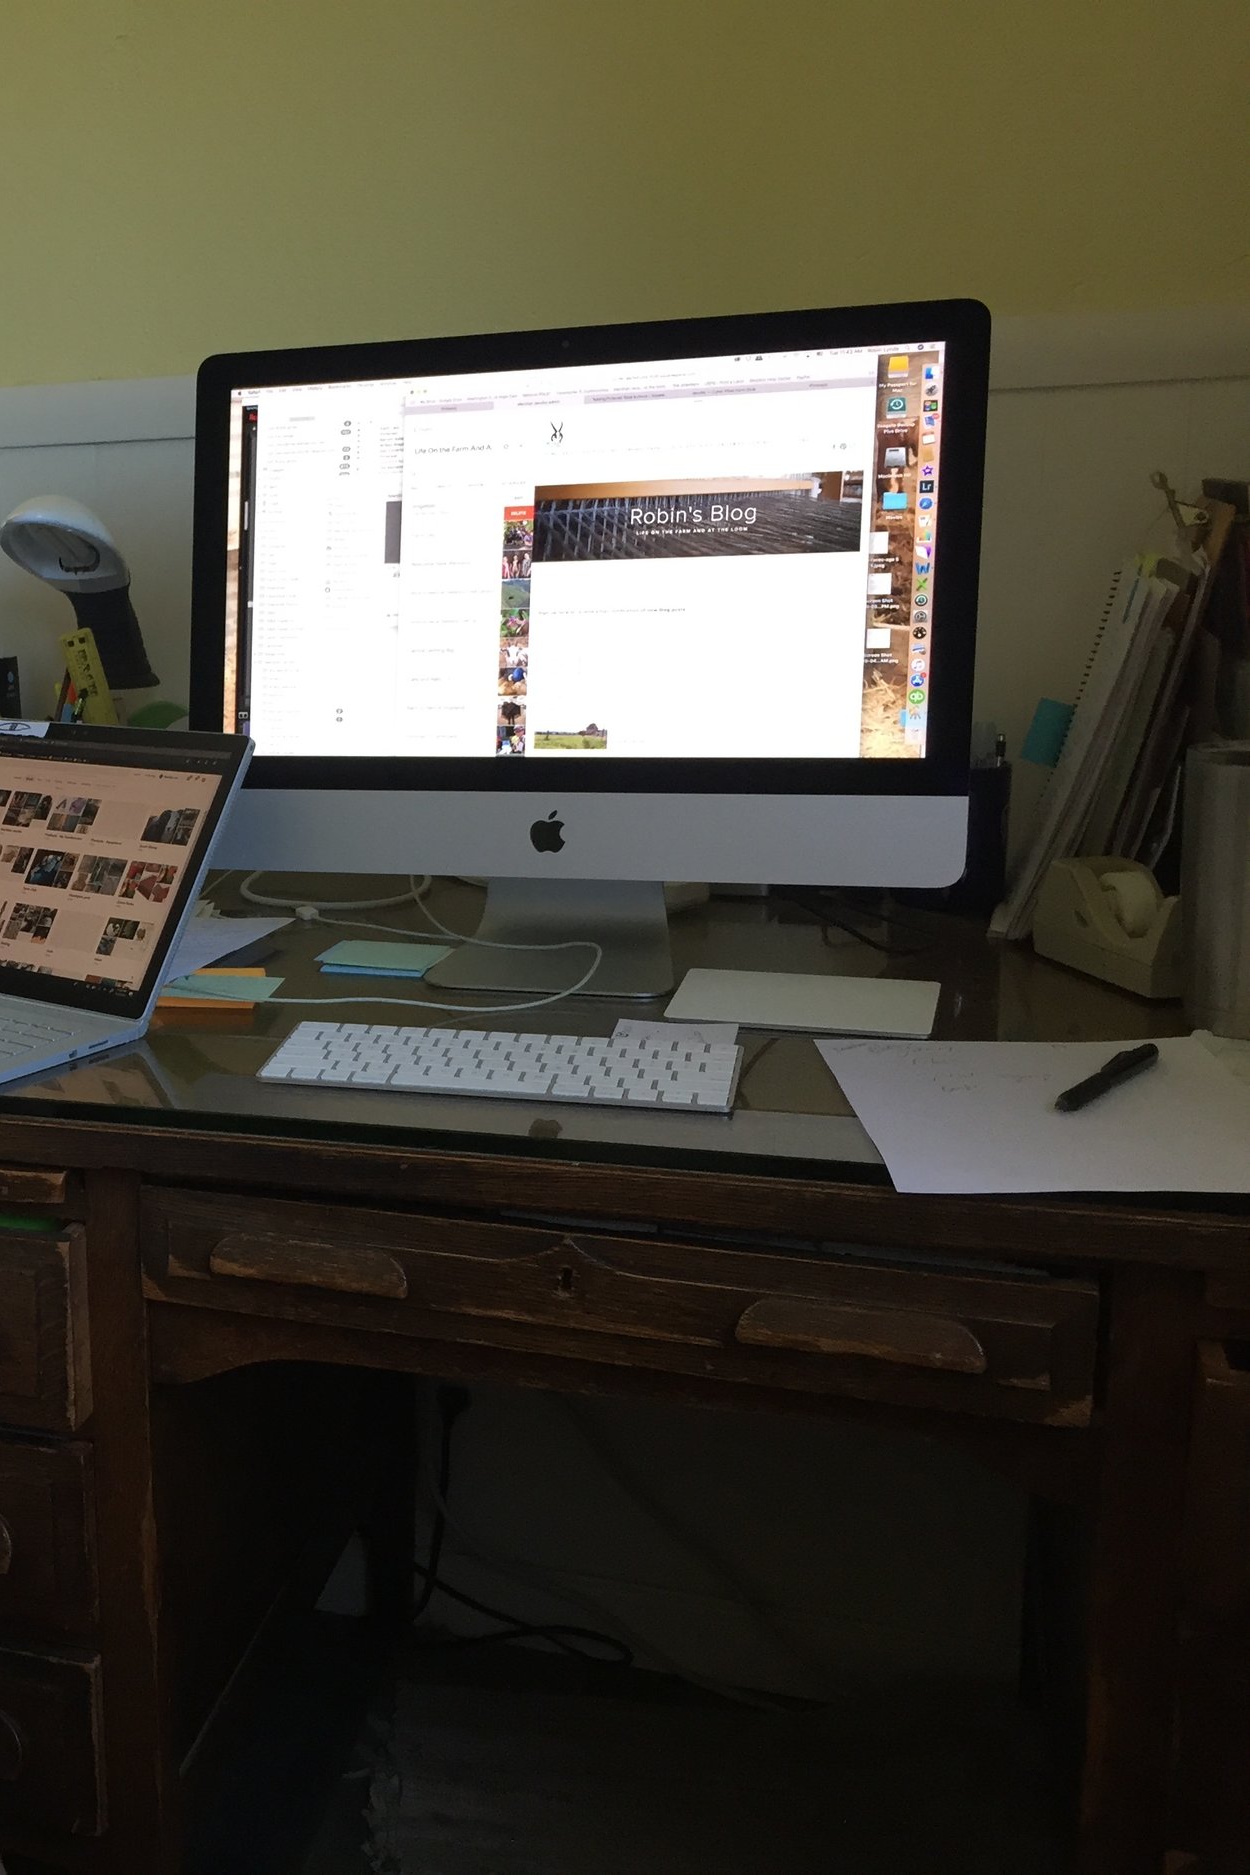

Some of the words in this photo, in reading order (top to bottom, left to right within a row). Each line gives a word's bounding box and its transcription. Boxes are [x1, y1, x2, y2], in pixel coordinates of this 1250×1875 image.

[922, 482, 932, 491] Lr
[630, 505, 703, 526] Robin's
[710, 504, 757, 526] Blog
